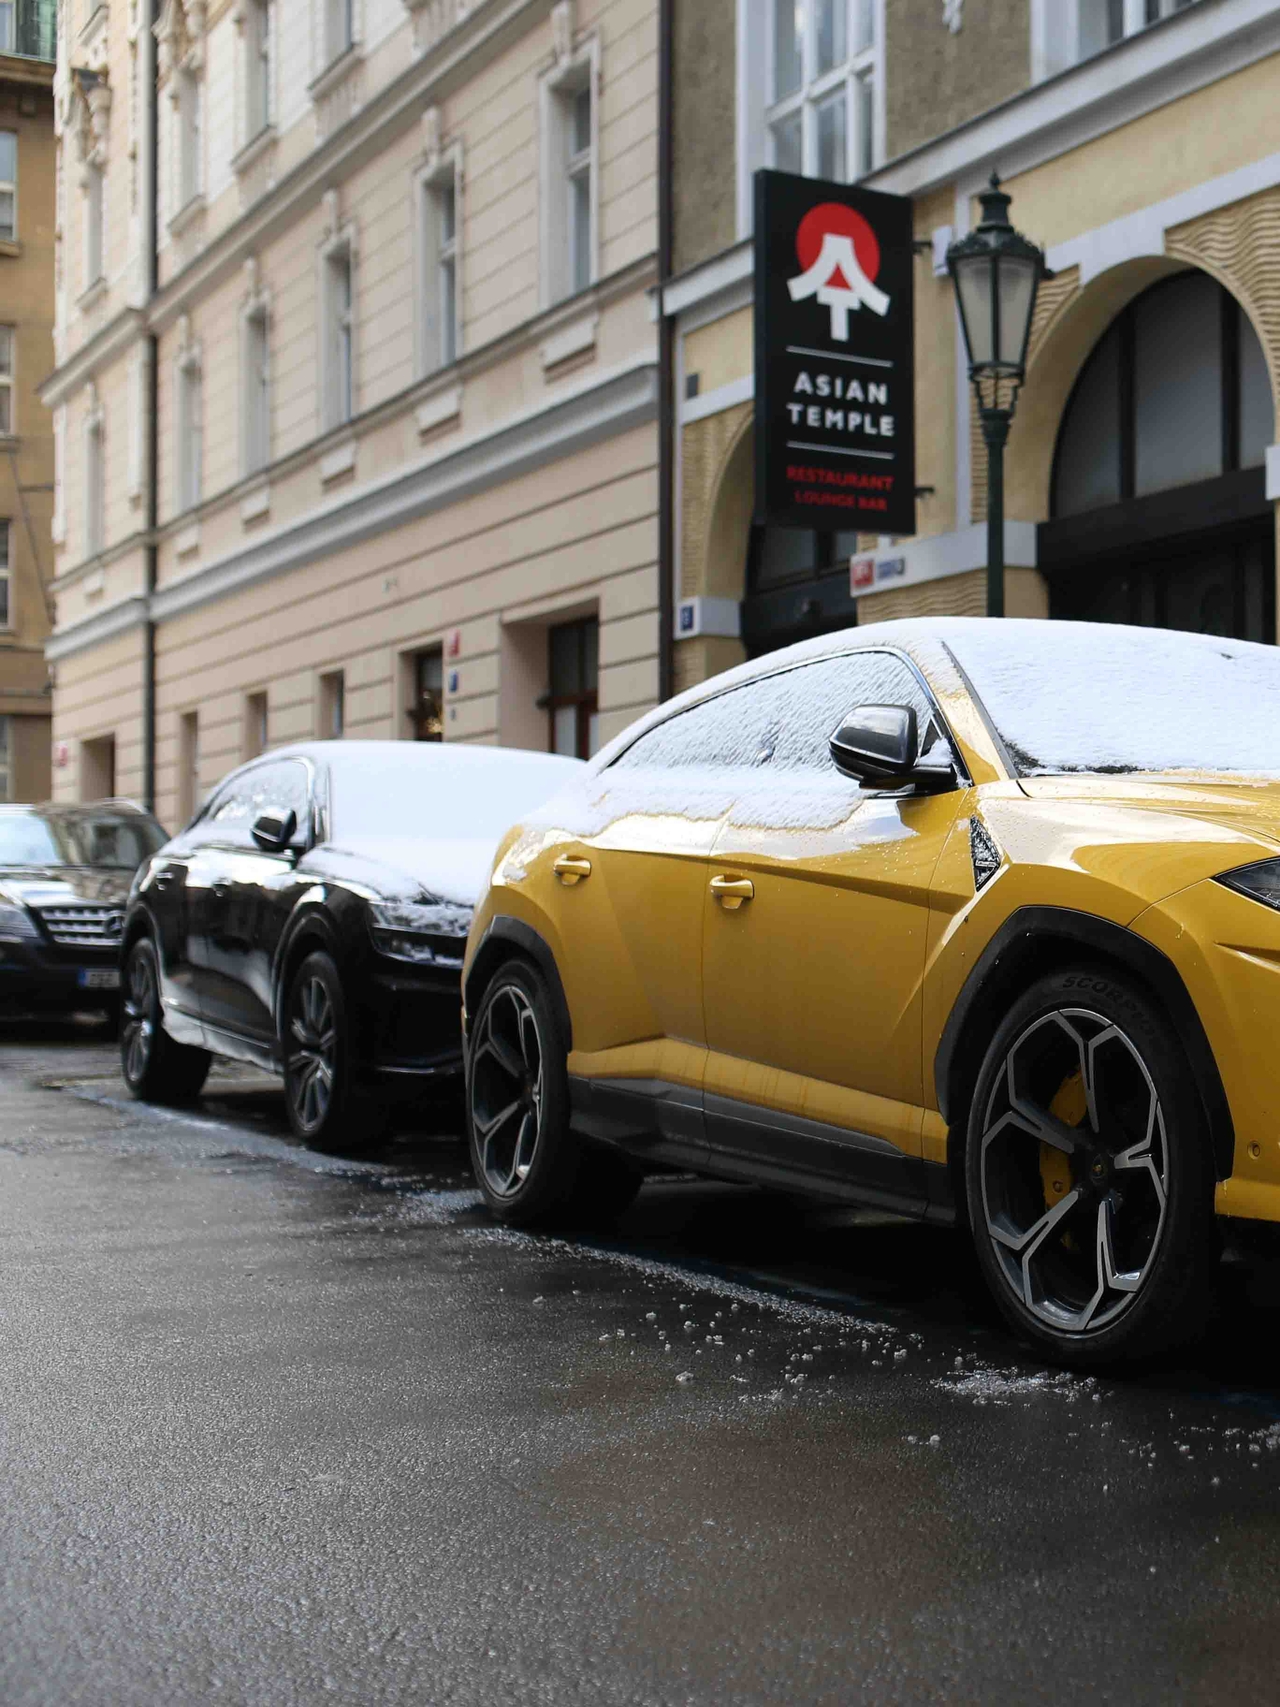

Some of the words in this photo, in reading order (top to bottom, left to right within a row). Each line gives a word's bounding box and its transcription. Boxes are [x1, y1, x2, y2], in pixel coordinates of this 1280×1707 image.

[793, 371, 887, 405] ASIAN
[786, 402, 895, 436] TEMPLE
[786, 465, 895, 492] RESTAURANT
[794, 490, 855, 508] LOUNGE
[858, 495, 887, 512] BAR
